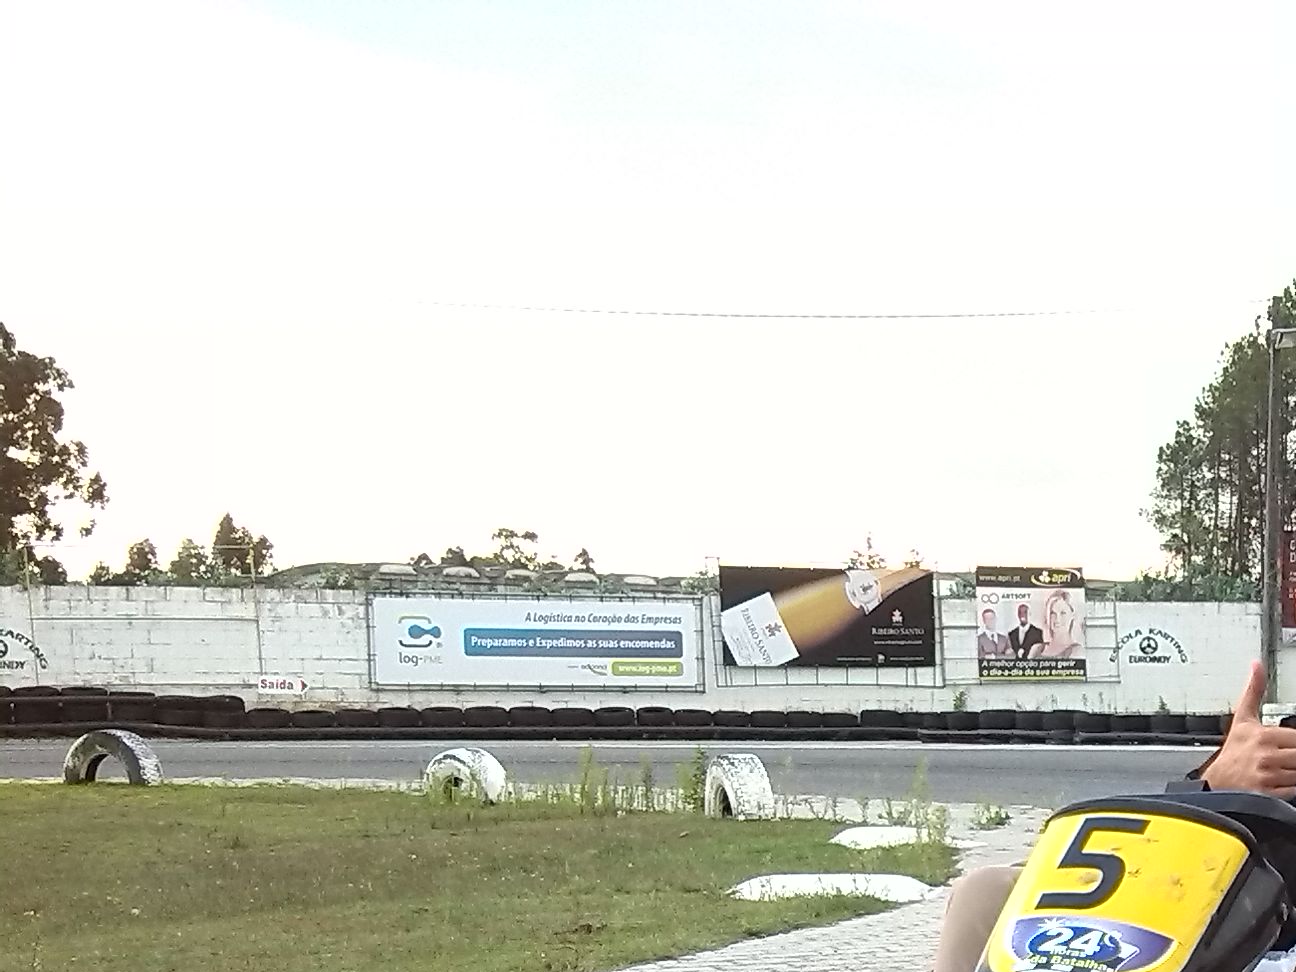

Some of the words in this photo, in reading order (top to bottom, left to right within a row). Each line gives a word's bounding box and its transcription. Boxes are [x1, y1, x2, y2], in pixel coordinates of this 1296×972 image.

[1052, 573, 1071, 584] apri
[525, 612, 532, 622] A
[623, 613, 639, 624] das
[641, 613, 682, 625] Empresas
[471, 636, 527, 648] Preparamos
[529, 639, 534, 647] e
[536, 637, 585, 649] Expedimos
[587, 639, 597, 648] as
[598, 639, 618, 648] suas
[620, 638, 676, 648] encomendas
[1149, 628, 1188, 663] KARTING
[1034, 817, 1151, 910] 5
[1037, 926, 1103, 956] 24
[1029, 954, 1047, 964] da
[1050, 955, 1107, 972] Batalha
